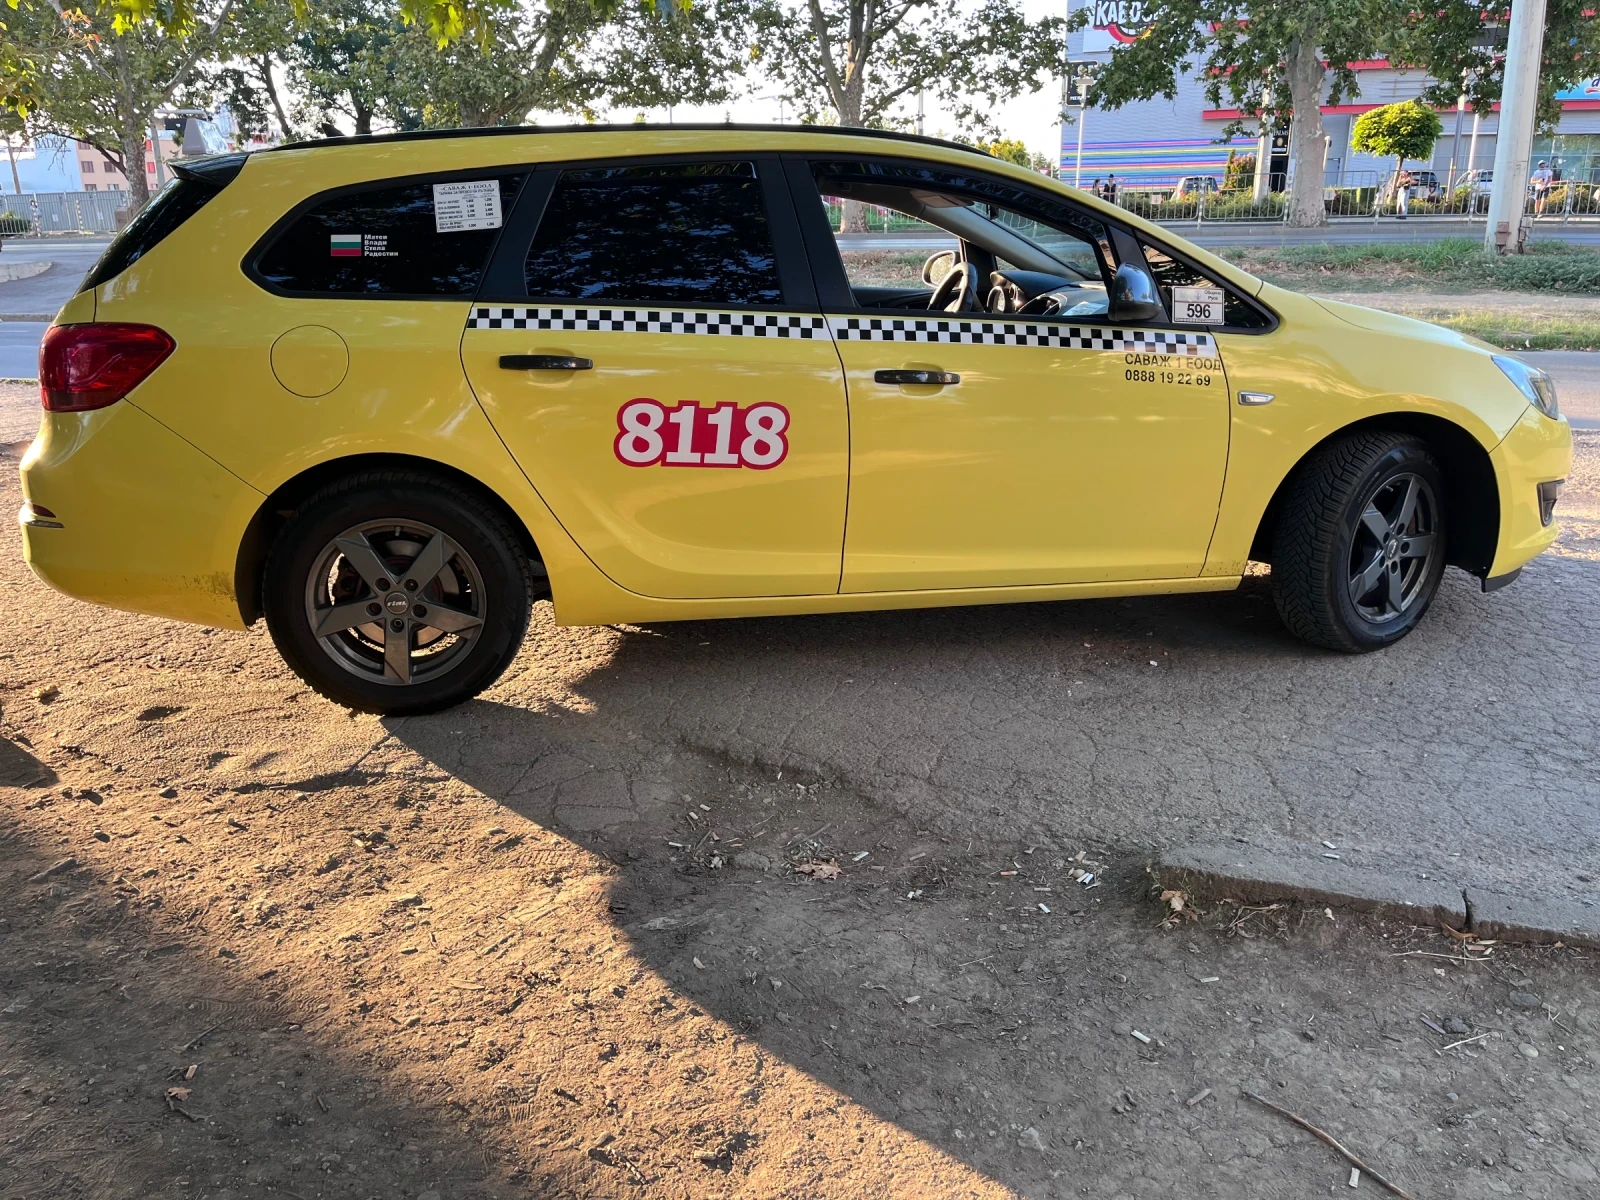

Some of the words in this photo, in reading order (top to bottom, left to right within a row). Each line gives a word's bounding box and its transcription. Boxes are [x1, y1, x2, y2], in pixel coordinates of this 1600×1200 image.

[1186, 303, 1212, 319] 596
[1124, 353, 1172, 368] САВАЖ
[1175, 357, 1181, 369] 1
[1186, 357, 1221, 373] ЕООД
[1125, 369, 1155, 383] 0888
[1160, 371, 1174, 384] 19
[1177, 373, 1192, 385] 22
[1196, 374, 1211, 386] 69
[618, 402, 787, 466] 8118
